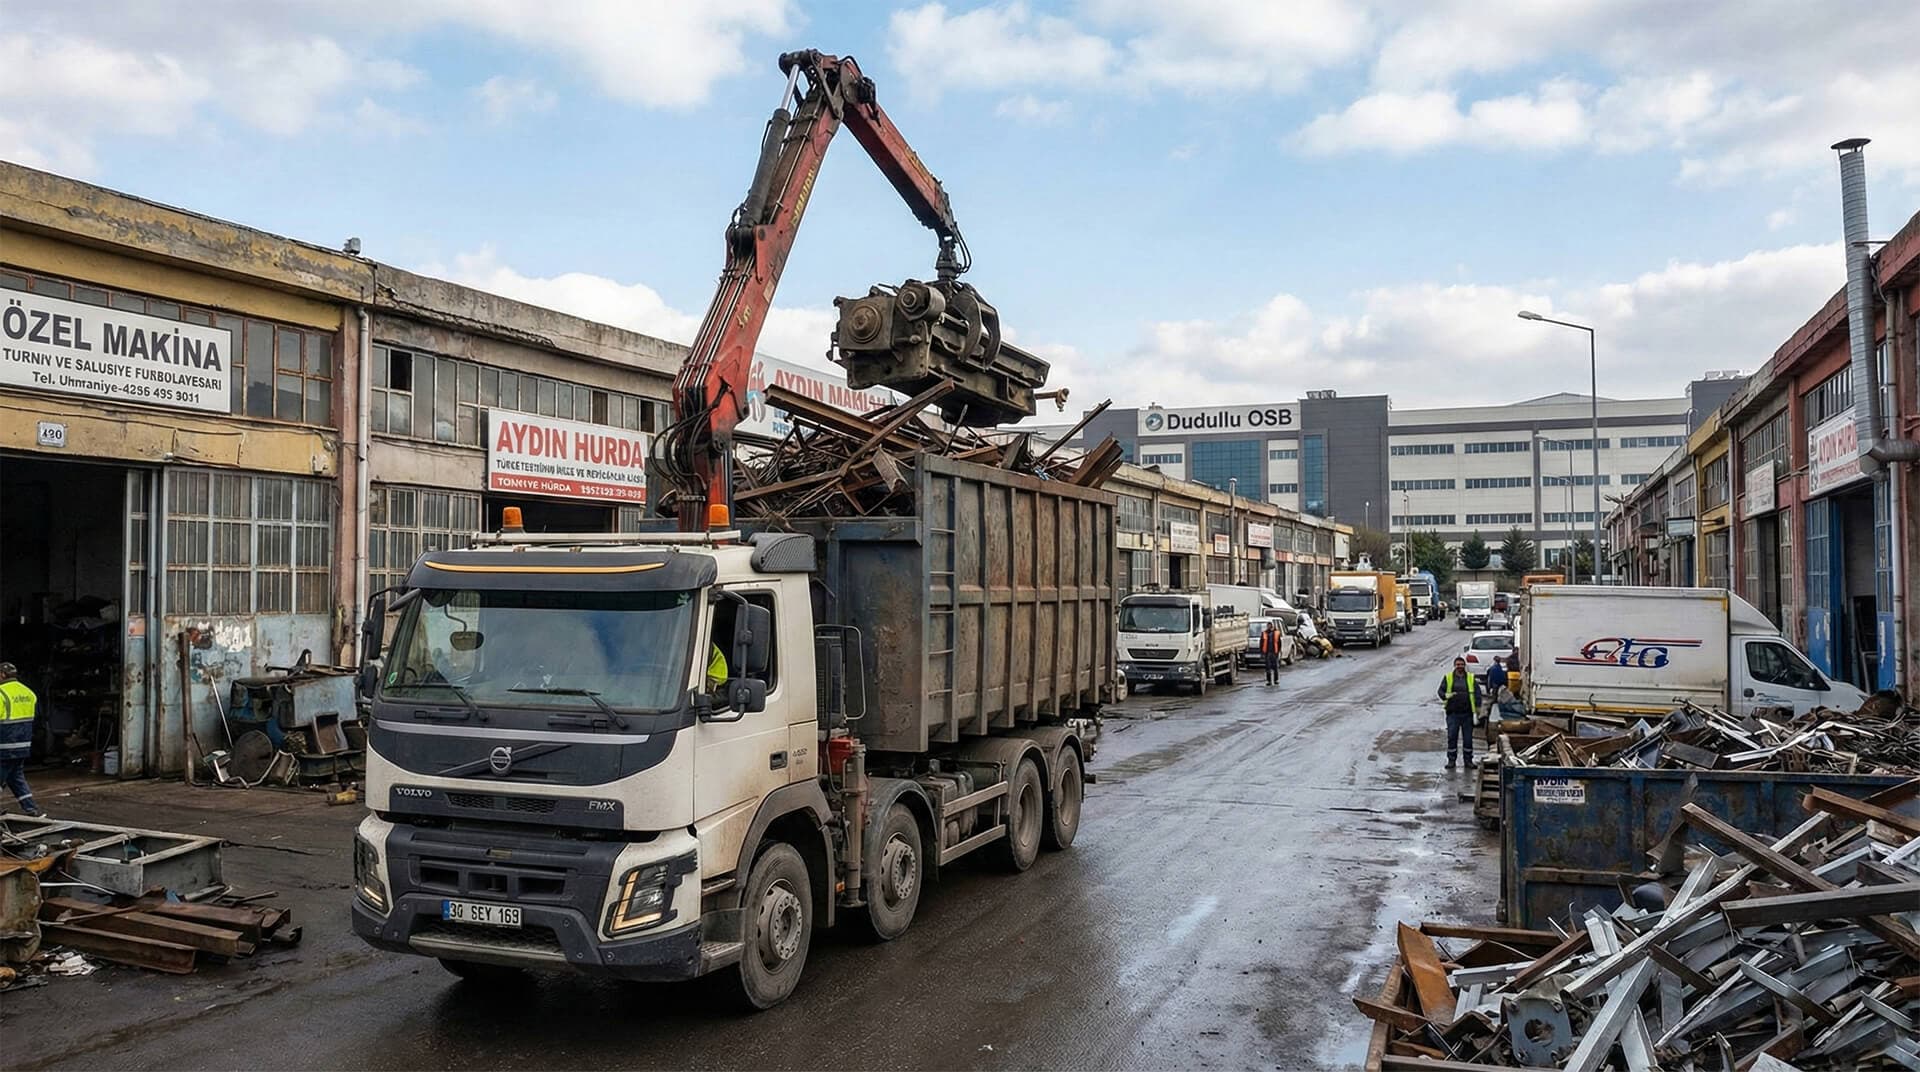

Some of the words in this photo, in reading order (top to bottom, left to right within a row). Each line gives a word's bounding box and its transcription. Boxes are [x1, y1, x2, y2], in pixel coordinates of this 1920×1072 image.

[3, 298, 92, 351] ÖZEL
[103, 322, 222, 372] MAKİNA
[55, 355, 72, 370] VE
[32, 371, 56, 385] Tel.
[774, 369, 824, 402] AYDIN
[1167, 411, 1241, 430] Dudullu
[1247, 409, 1292, 427] OSB
[496, 421, 567, 460] AYDIN
[574, 431, 644, 470] HURDA
[395, 787, 432, 798] VOLVO
[588, 800, 616, 812] FMX
[471, 905, 492, 921] SEY
[498, 908, 519, 924] 169
